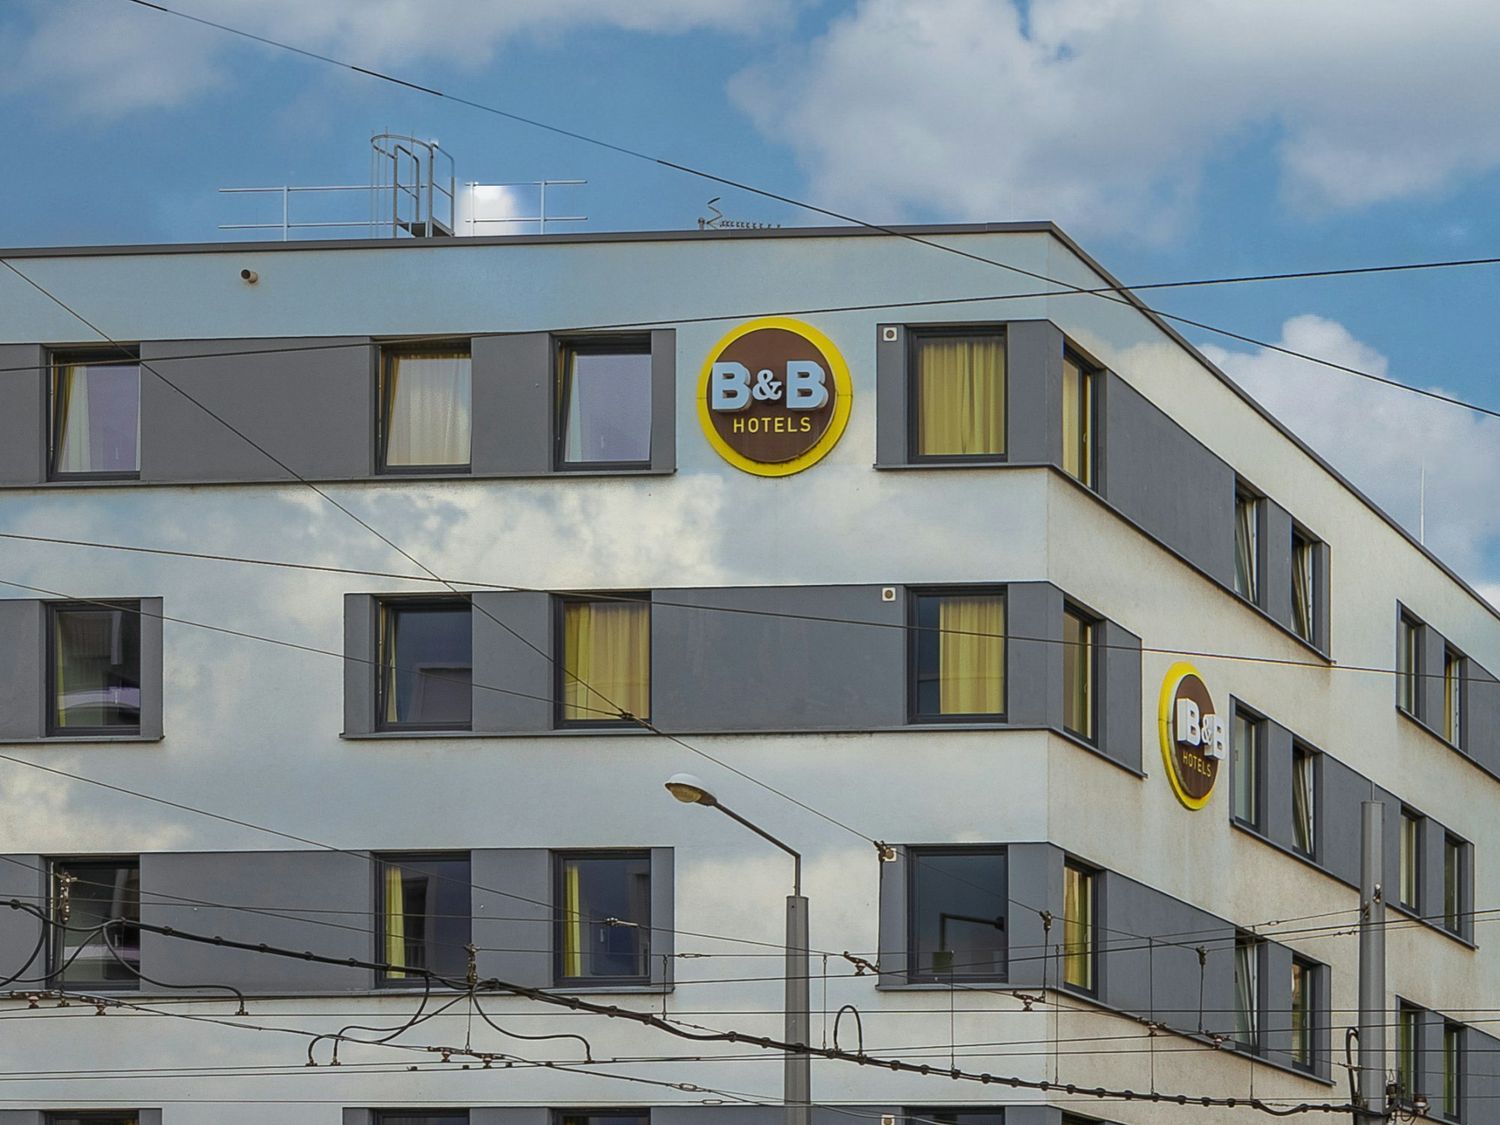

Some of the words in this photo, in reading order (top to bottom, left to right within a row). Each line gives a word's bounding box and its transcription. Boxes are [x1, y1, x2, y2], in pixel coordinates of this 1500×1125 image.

[711, 360, 829, 411] B&B
[733, 416, 812, 433] HOTELS
[1177, 698, 1226, 760] B&B
[1182, 751, 1212, 777] HOTELS
